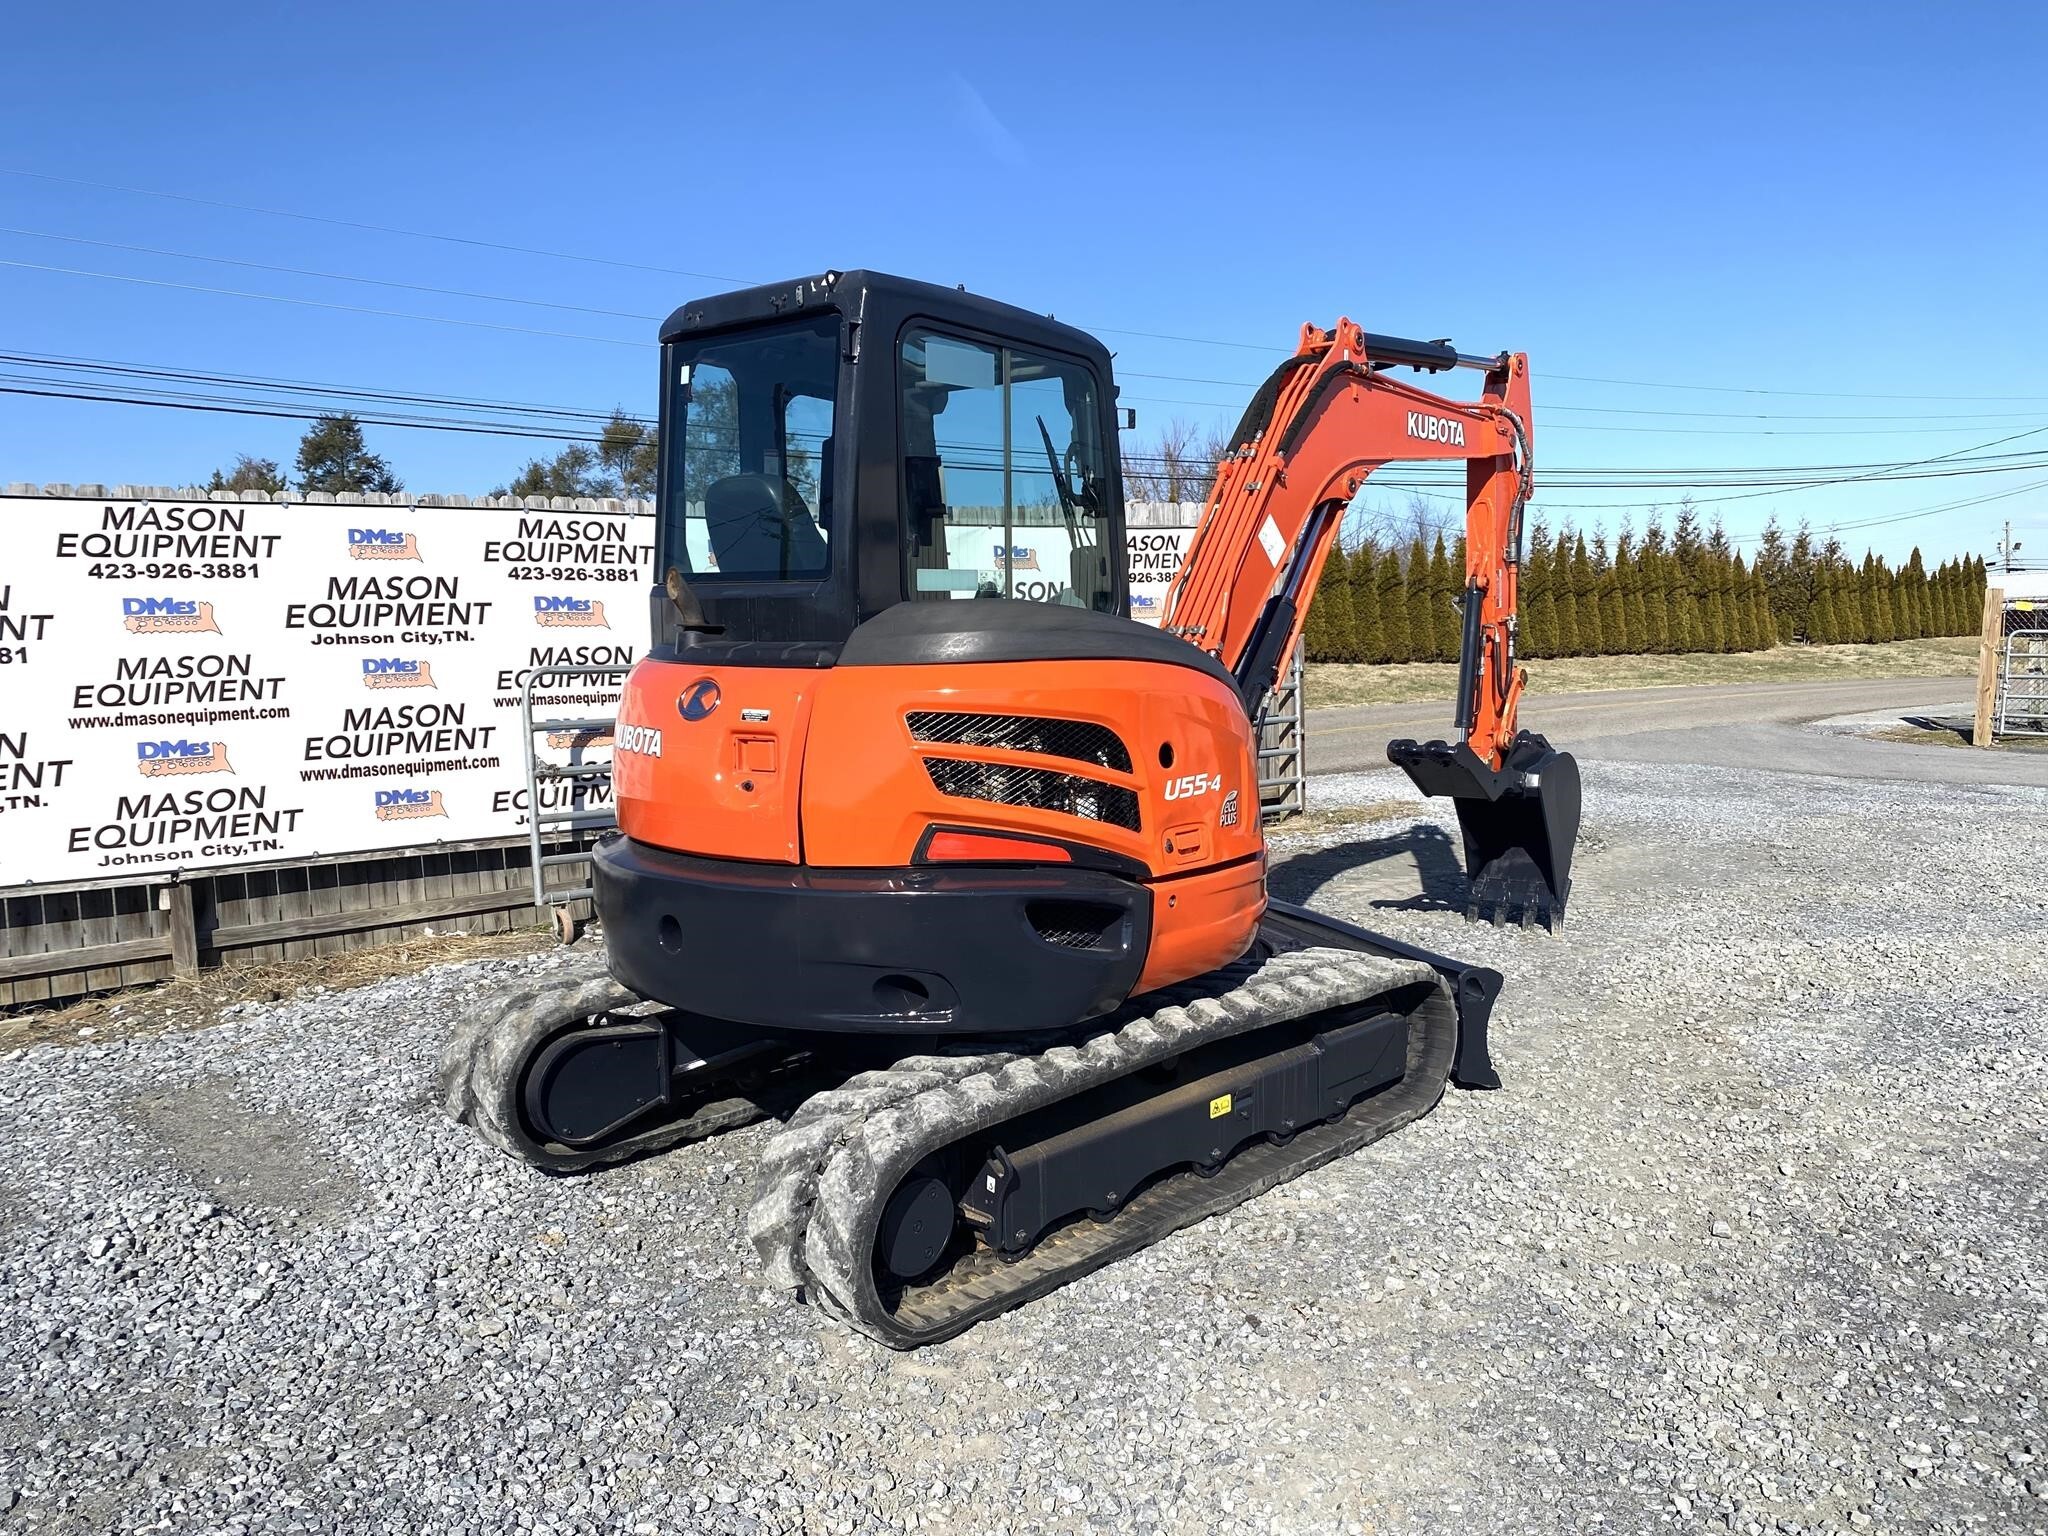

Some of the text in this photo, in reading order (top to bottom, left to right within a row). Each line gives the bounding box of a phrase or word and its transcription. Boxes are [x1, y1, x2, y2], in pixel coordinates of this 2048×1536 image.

[1407, 411, 1465, 447] KUBOTA
[101, 506, 245, 531] MASON
[517, 518, 626, 541] MASON
[56, 533, 281, 558] EQUIPMENT
[483, 541, 655, 565] EQUIPMENT
[1127, 535, 1180, 551] ASON
[88, 563, 259, 579] 423-926-3881
[507, 566, 639, 582] 423-926-3881
[327, 576, 459, 600] MASON
[285, 602, 492, 629] EQUIPMENT
[310, 630, 475, 646] Johnson City,TN.
[116, 655, 252, 680] MASON
[529, 646, 633, 666] MASON
[73, 678, 286, 709] EQUIPMENT
[68, 706, 290, 729] www.dmasonequipment.com
[342, 703, 465, 731] MASON
[304, 726, 496, 761] EQUIPMENT
[616, 724, 663, 759] UBOTA
[300, 755, 500, 782] www.dmasonequipment.com
[1164, 773, 1222, 801] U55-4
[116, 786, 266, 820] MASON
[68, 809, 304, 852] EQUIPMENT
[1220, 812, 1237, 827] PLUS
[97, 838, 285, 867] Johnson City,TN.
